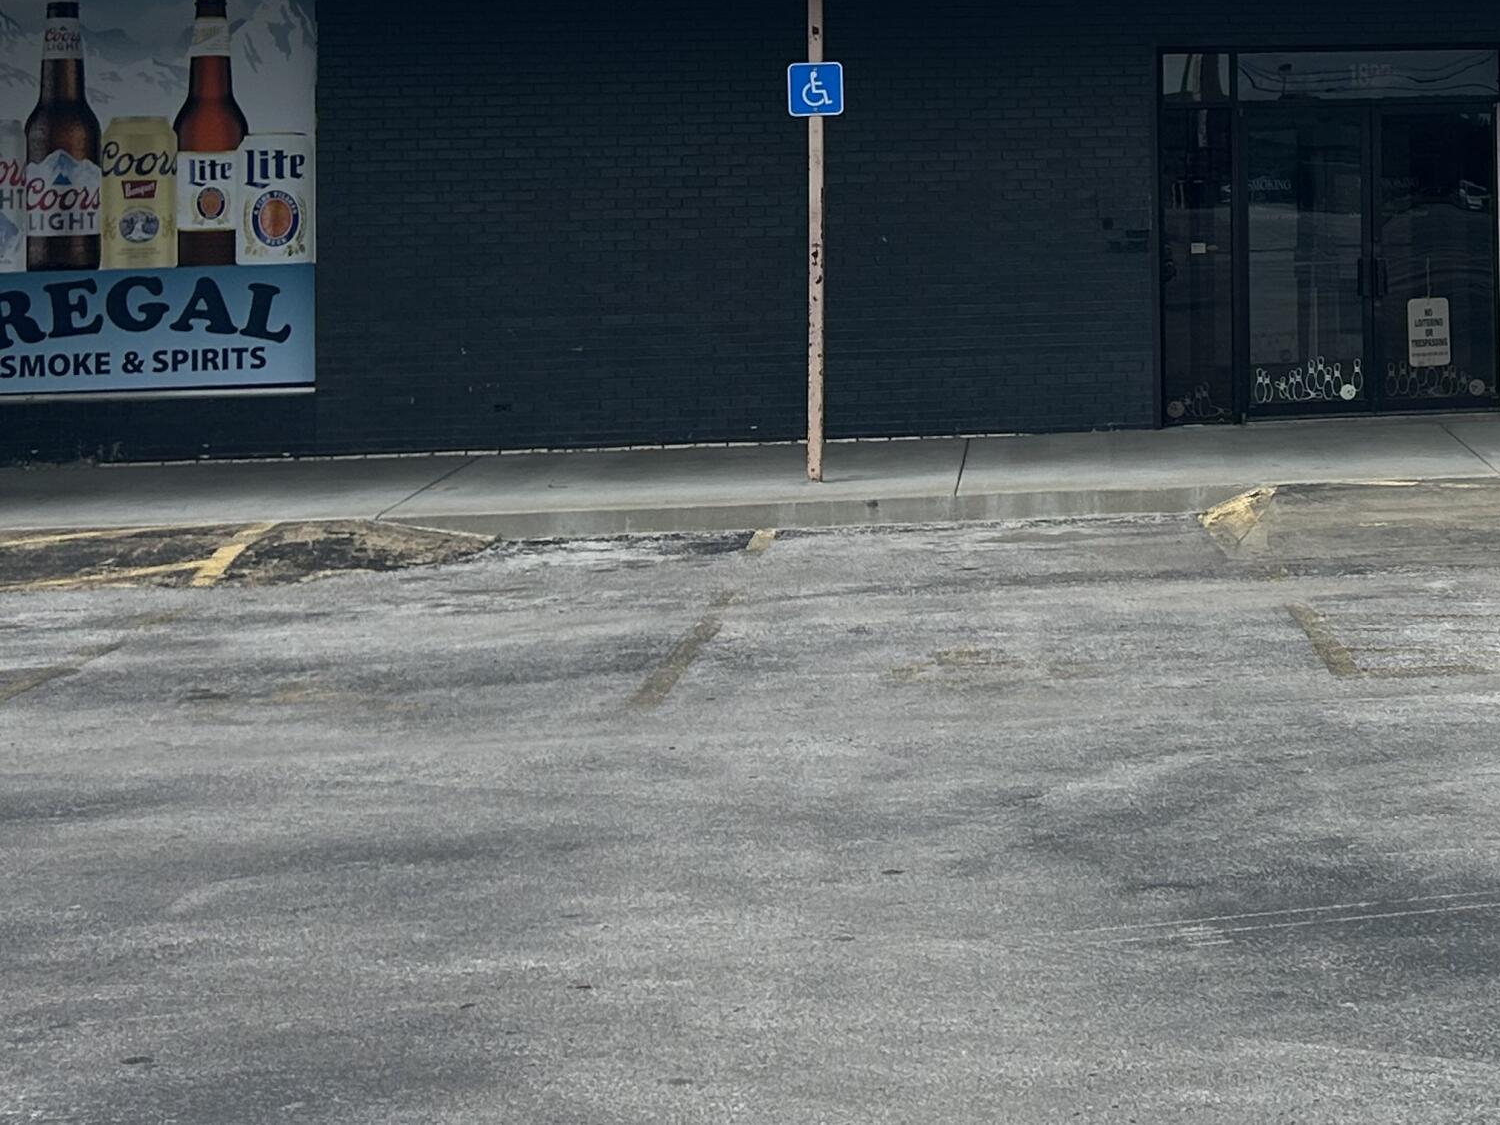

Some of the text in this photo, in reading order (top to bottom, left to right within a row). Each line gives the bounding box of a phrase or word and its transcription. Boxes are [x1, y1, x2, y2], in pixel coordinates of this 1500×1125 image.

[45, 28, 81, 42] Coors
[189, 160, 232, 186] Lite
[245, 150, 305, 189] Lite
[26, 178, 100, 211] Coors
[29, 213, 96, 230] LIGHT
[0, 276, 292, 350] REGAL
[1, 346, 267, 378] SMOKE & SPIRITS
